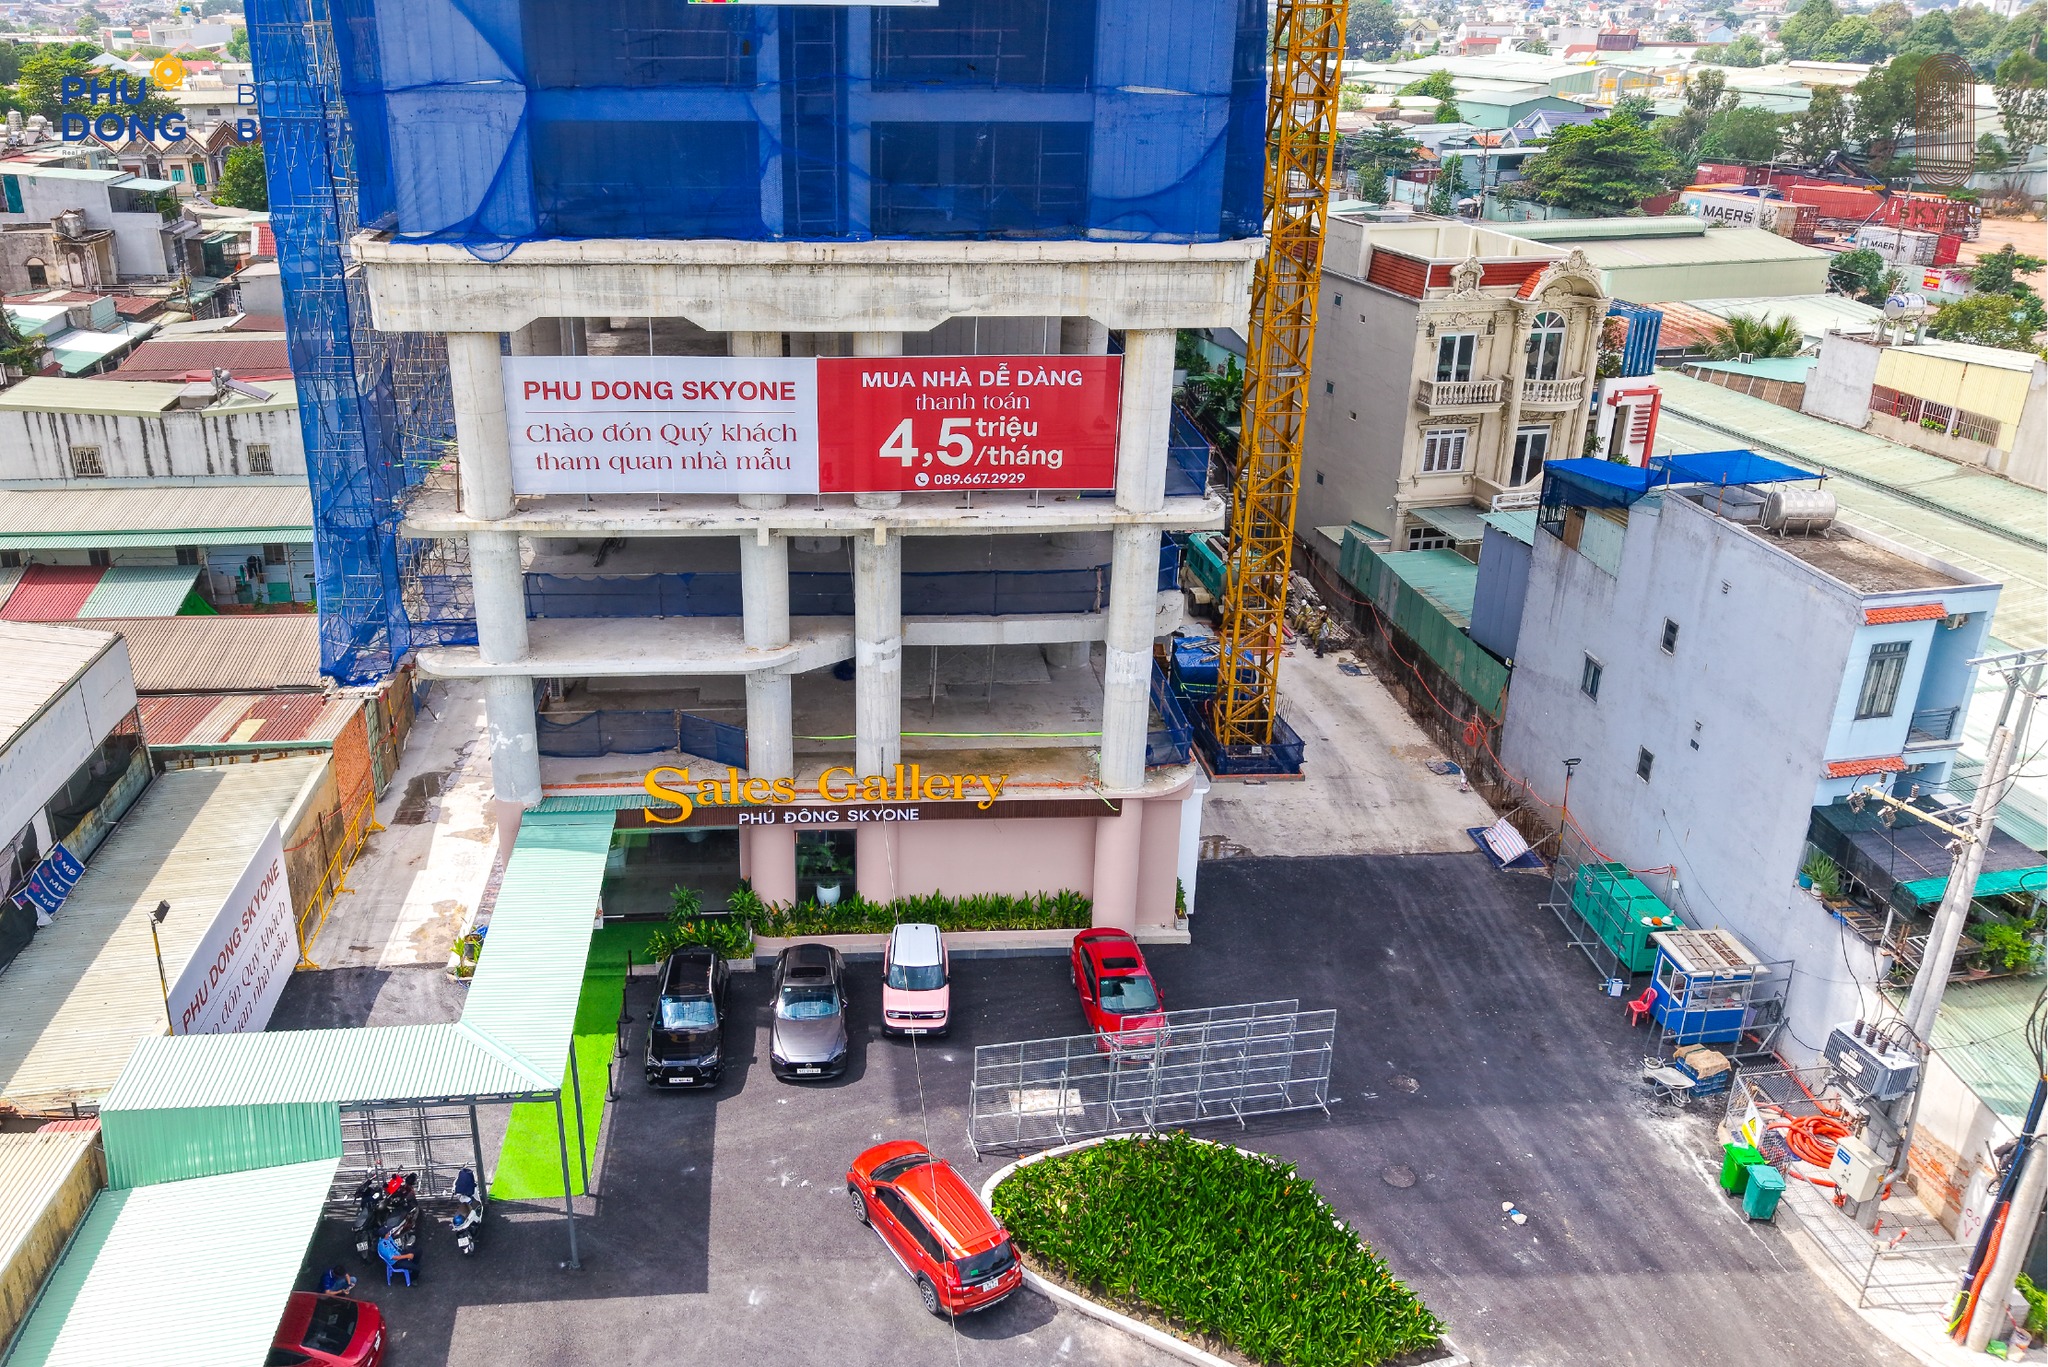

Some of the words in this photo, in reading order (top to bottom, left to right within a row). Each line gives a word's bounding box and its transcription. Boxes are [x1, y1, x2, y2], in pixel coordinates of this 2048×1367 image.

[1702, 204, 1757, 224] MAERS
[1870, 240, 1907, 252] MAERK
[862, 372, 916, 388] MUA
[923, 366, 972, 387] NHÀ
[979, 363, 1010, 386] DỄ
[1017, 366, 1083, 386] DÀNG
[524, 381, 581, 400] PHU
[592, 381, 673, 400] DONG
[682, 381, 796, 400] SKYONE
[915, 394, 975, 411] thanh
[983, 391, 1030, 410] toán
[526, 422, 594, 442] Chào
[602, 421, 651, 442] đón
[660, 421, 712, 446] Quý
[722, 421, 797, 442] khách
[976, 416, 1038, 442] triệu
[879, 417, 974, 467] 4,5
[536, 452, 600, 470] tham
[608, 453, 673, 474] quan
[681, 450, 727, 470] nhà
[737, 447, 791, 470] mẫu
[974, 445, 1063, 469] /tháng
[934, 473, 1026, 485] 089.667.2929
[644, 766, 796, 824] Sales
[818, 763, 1010, 811] Gallery
[738, 807, 775, 825] PHÚ
[784, 808, 839, 824] ĐÔNG
[847, 808, 919, 822] SKYONE
[182, 980, 209, 1035] PHU
[209, 926, 242, 989] DONG
[242, 858, 280, 934] SKYONE
[221, 985, 242, 1025] đón
[241, 943, 260, 987] Quý
[260, 901, 286, 953] khách
[253, 965, 270, 1006] nhà
